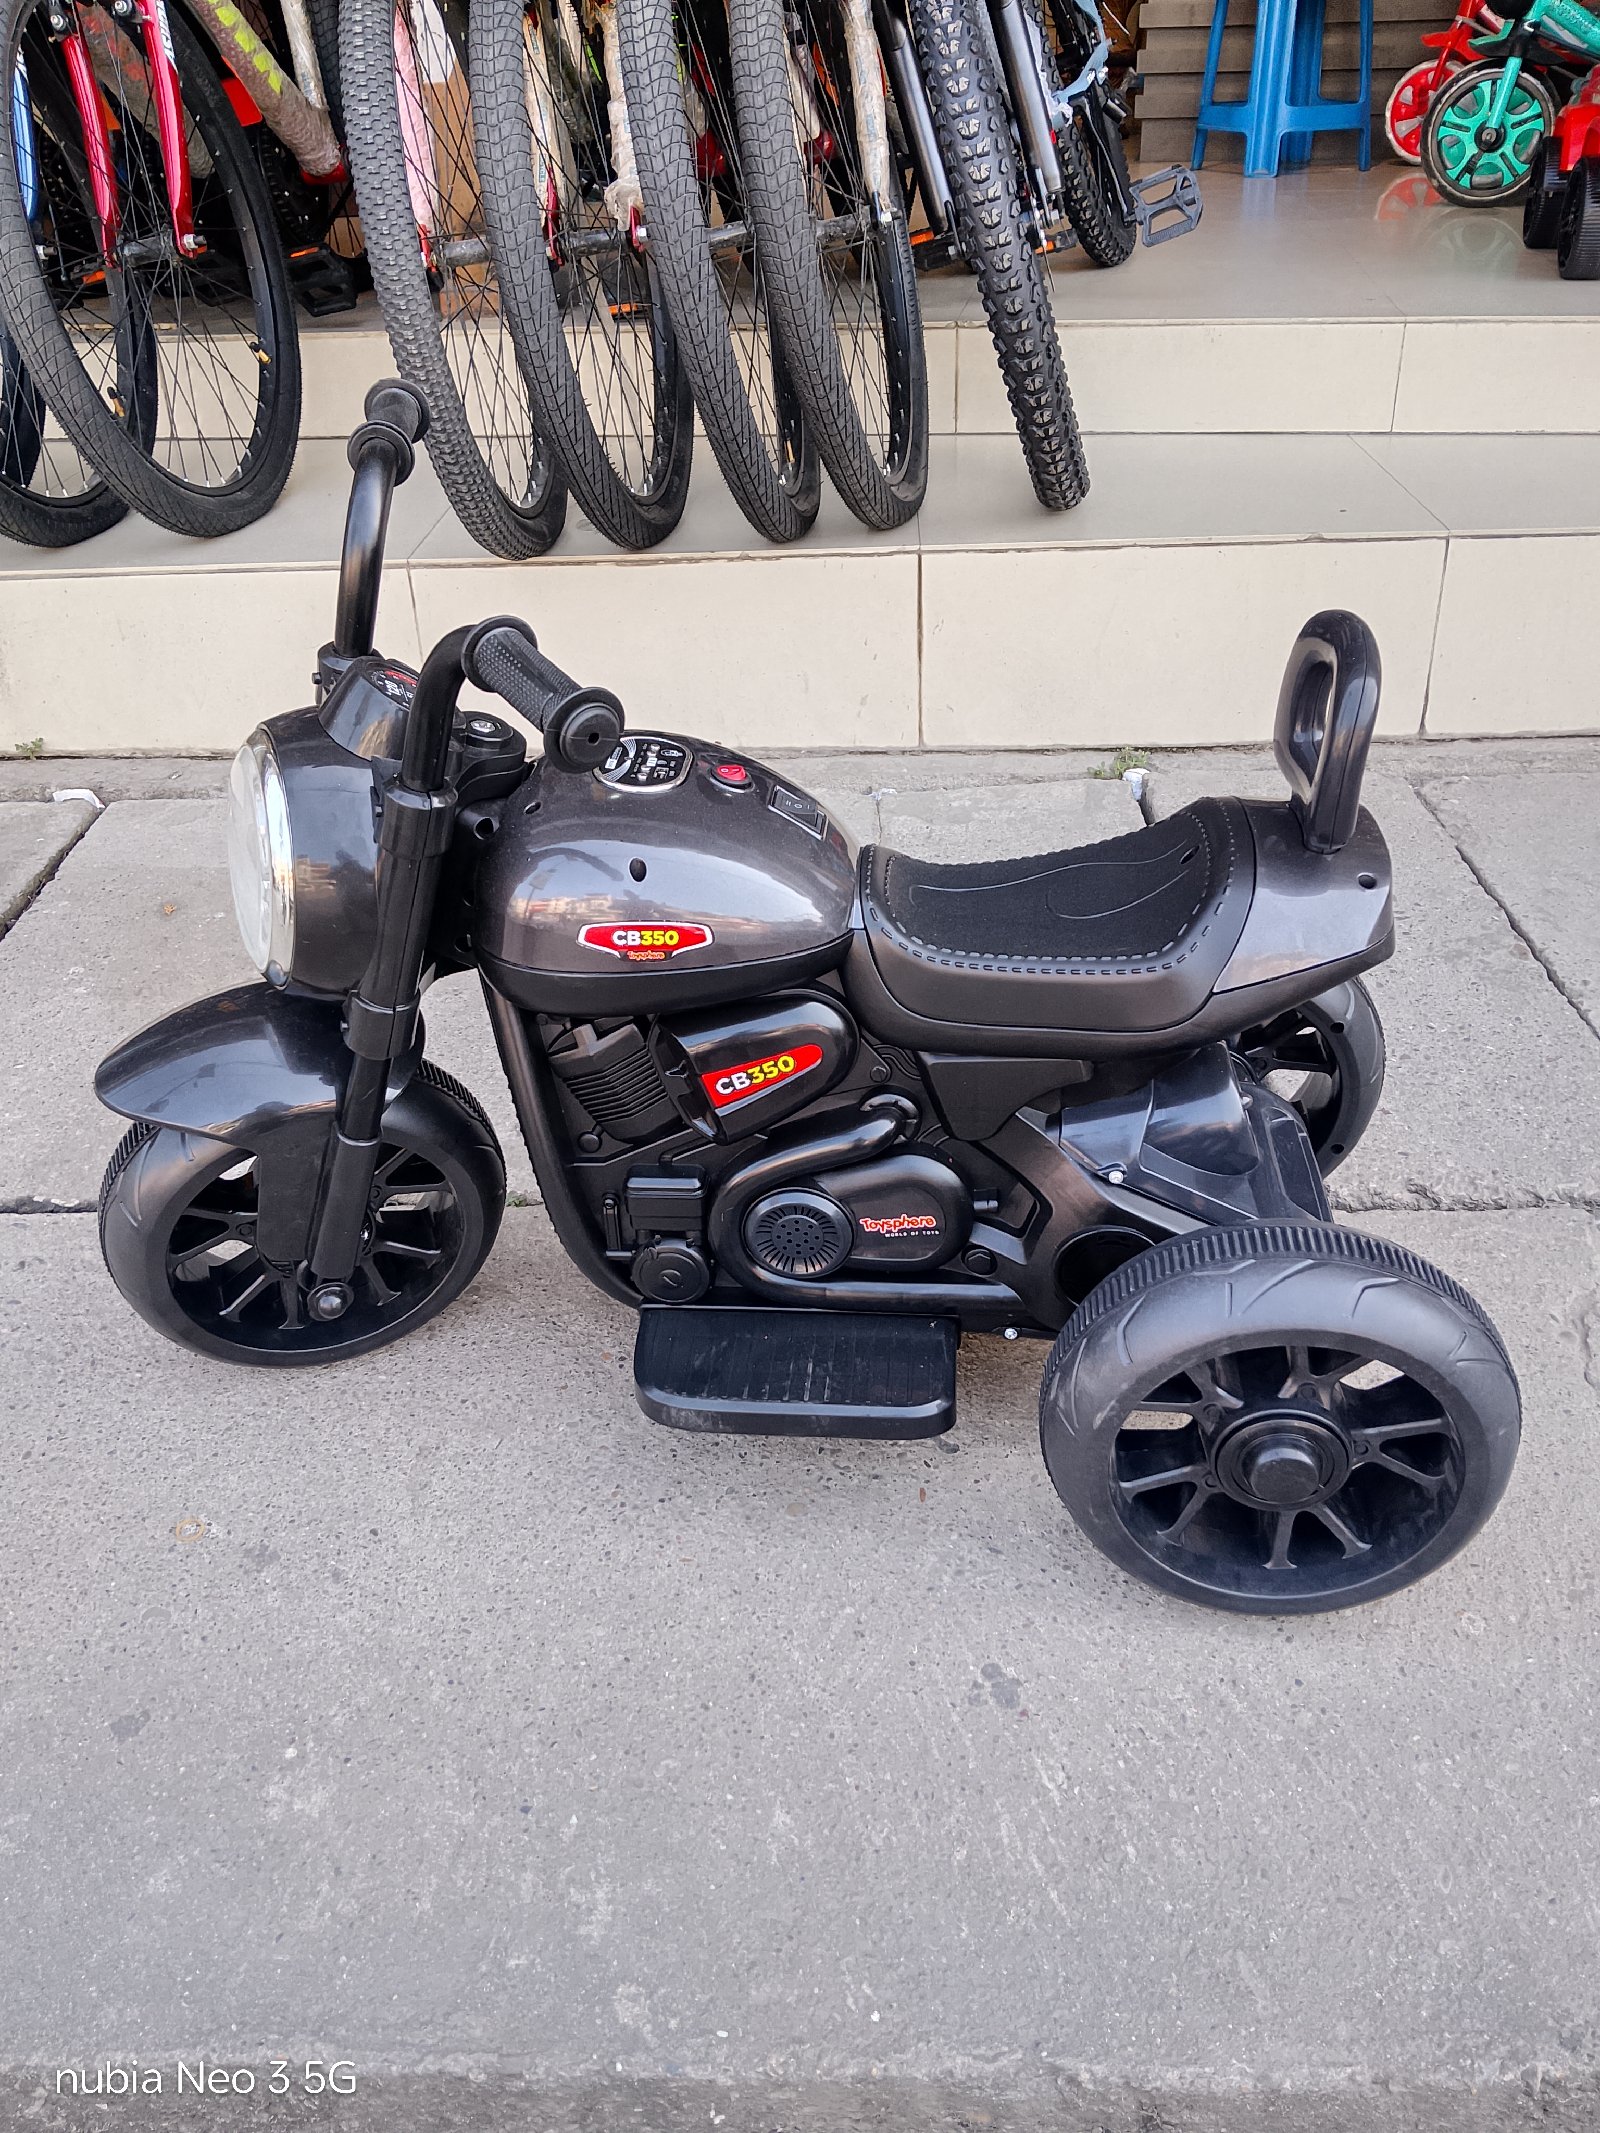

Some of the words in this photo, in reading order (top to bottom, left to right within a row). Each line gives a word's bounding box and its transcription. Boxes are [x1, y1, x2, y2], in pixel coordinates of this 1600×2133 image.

[612, 930, 679, 946] CB350
[715, 1055, 796, 1095] CB350
[859, 1213, 937, 1233] Toysphere
